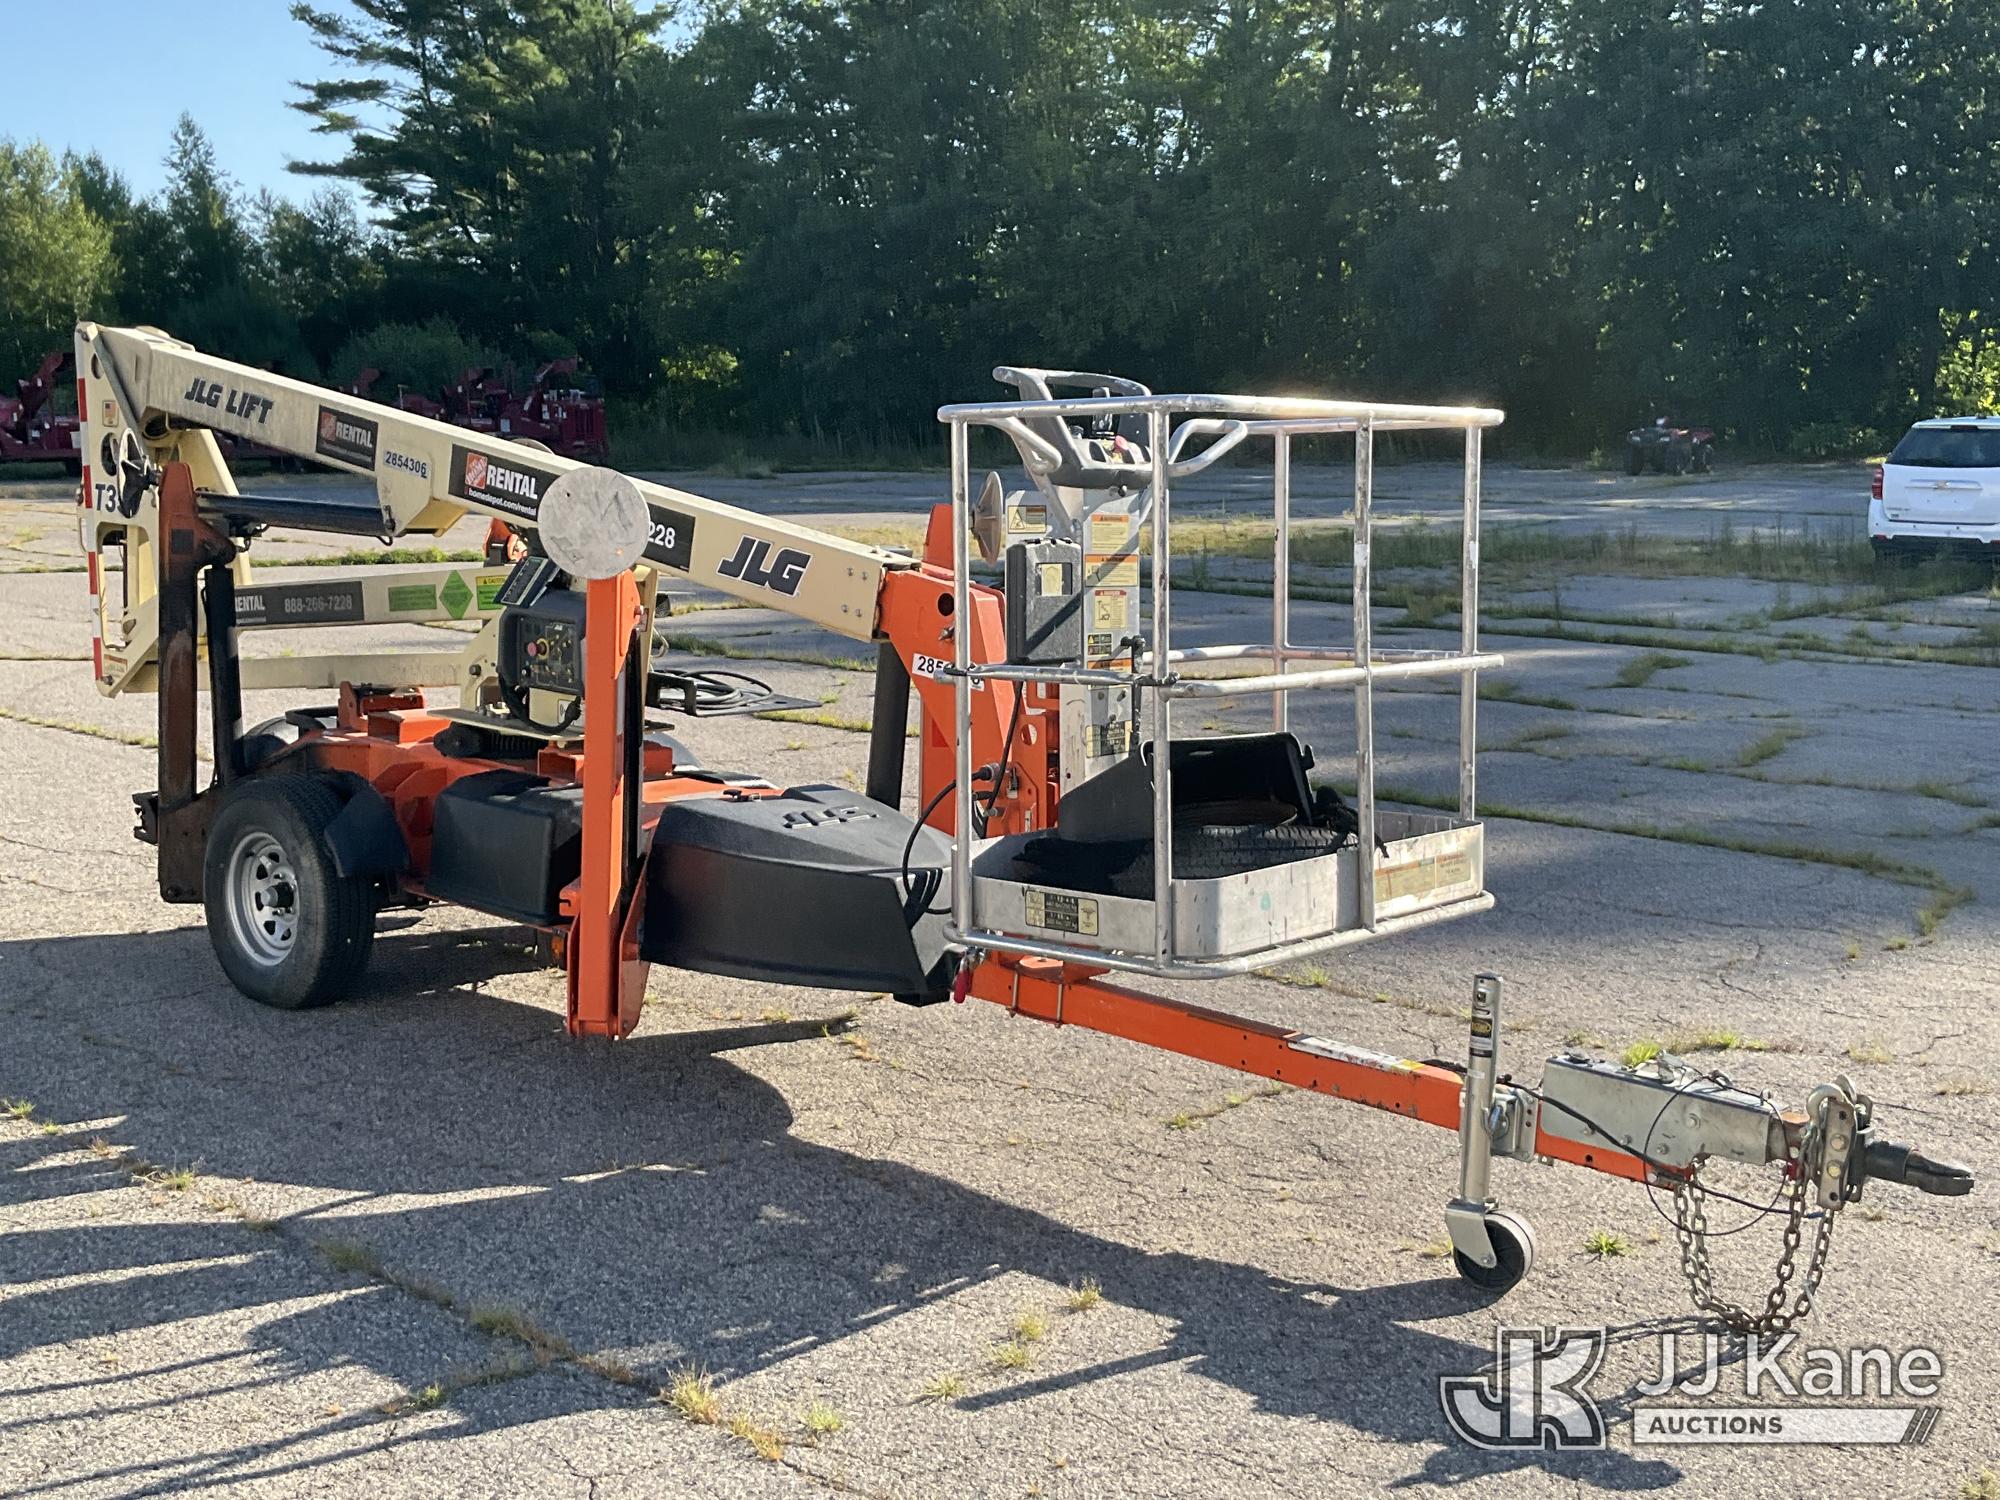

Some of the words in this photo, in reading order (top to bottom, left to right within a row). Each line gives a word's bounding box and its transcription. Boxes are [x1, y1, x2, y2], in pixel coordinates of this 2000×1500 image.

[184, 378, 224, 408] JLG
[225, 389, 274, 424] LIFT
[335, 421, 373, 448] RENTAL
[385, 451, 428, 478] 2854306
[486, 464, 538, 499] RENTAL
[716, 535, 813, 597] JLG
